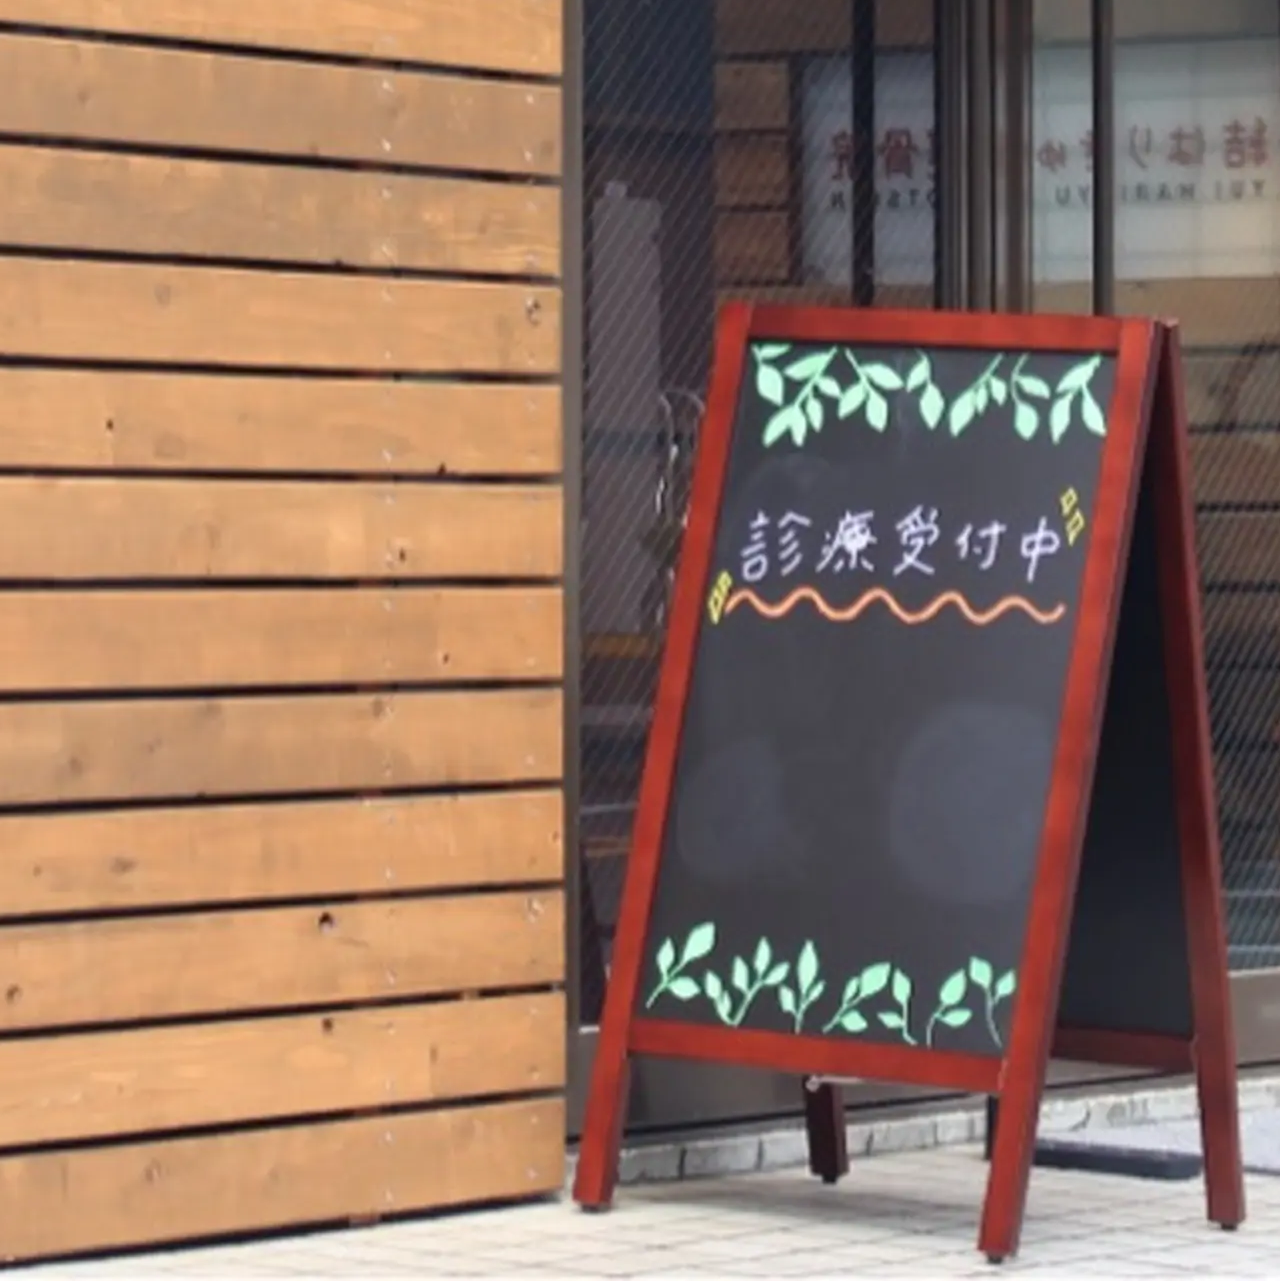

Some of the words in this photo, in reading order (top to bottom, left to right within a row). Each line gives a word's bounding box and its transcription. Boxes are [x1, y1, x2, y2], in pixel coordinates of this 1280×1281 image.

[739, 504, 1062, 584] 診療受付中
